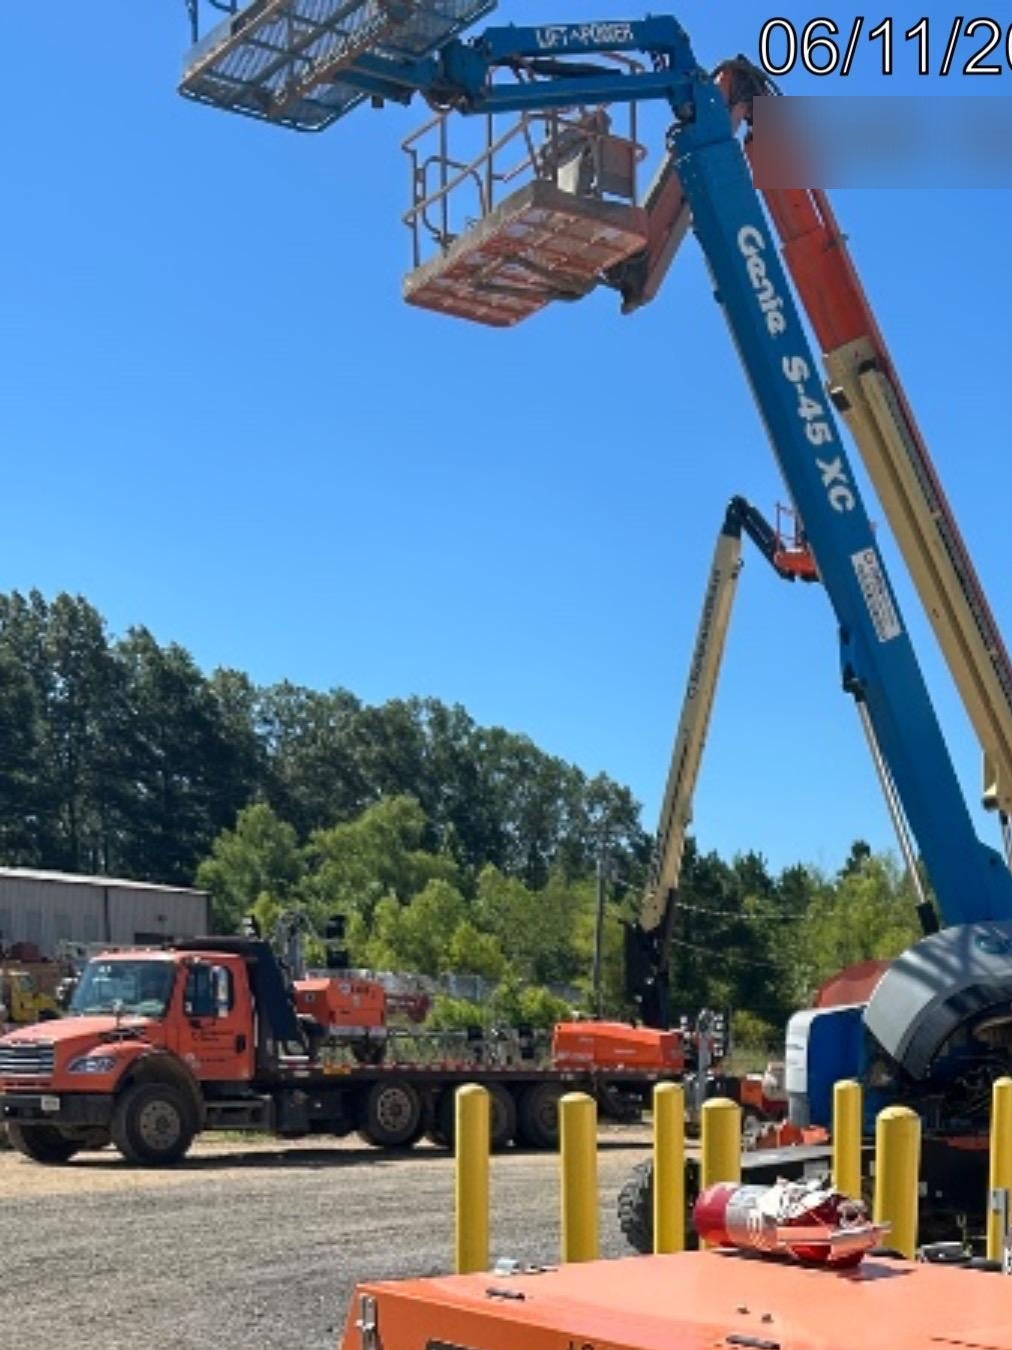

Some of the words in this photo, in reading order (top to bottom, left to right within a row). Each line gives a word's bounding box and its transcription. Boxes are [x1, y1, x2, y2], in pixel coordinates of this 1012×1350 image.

[737, 225, 787, 338] Genie
[782, 354, 833, 446] S-45
[816, 456, 855, 513] XC
